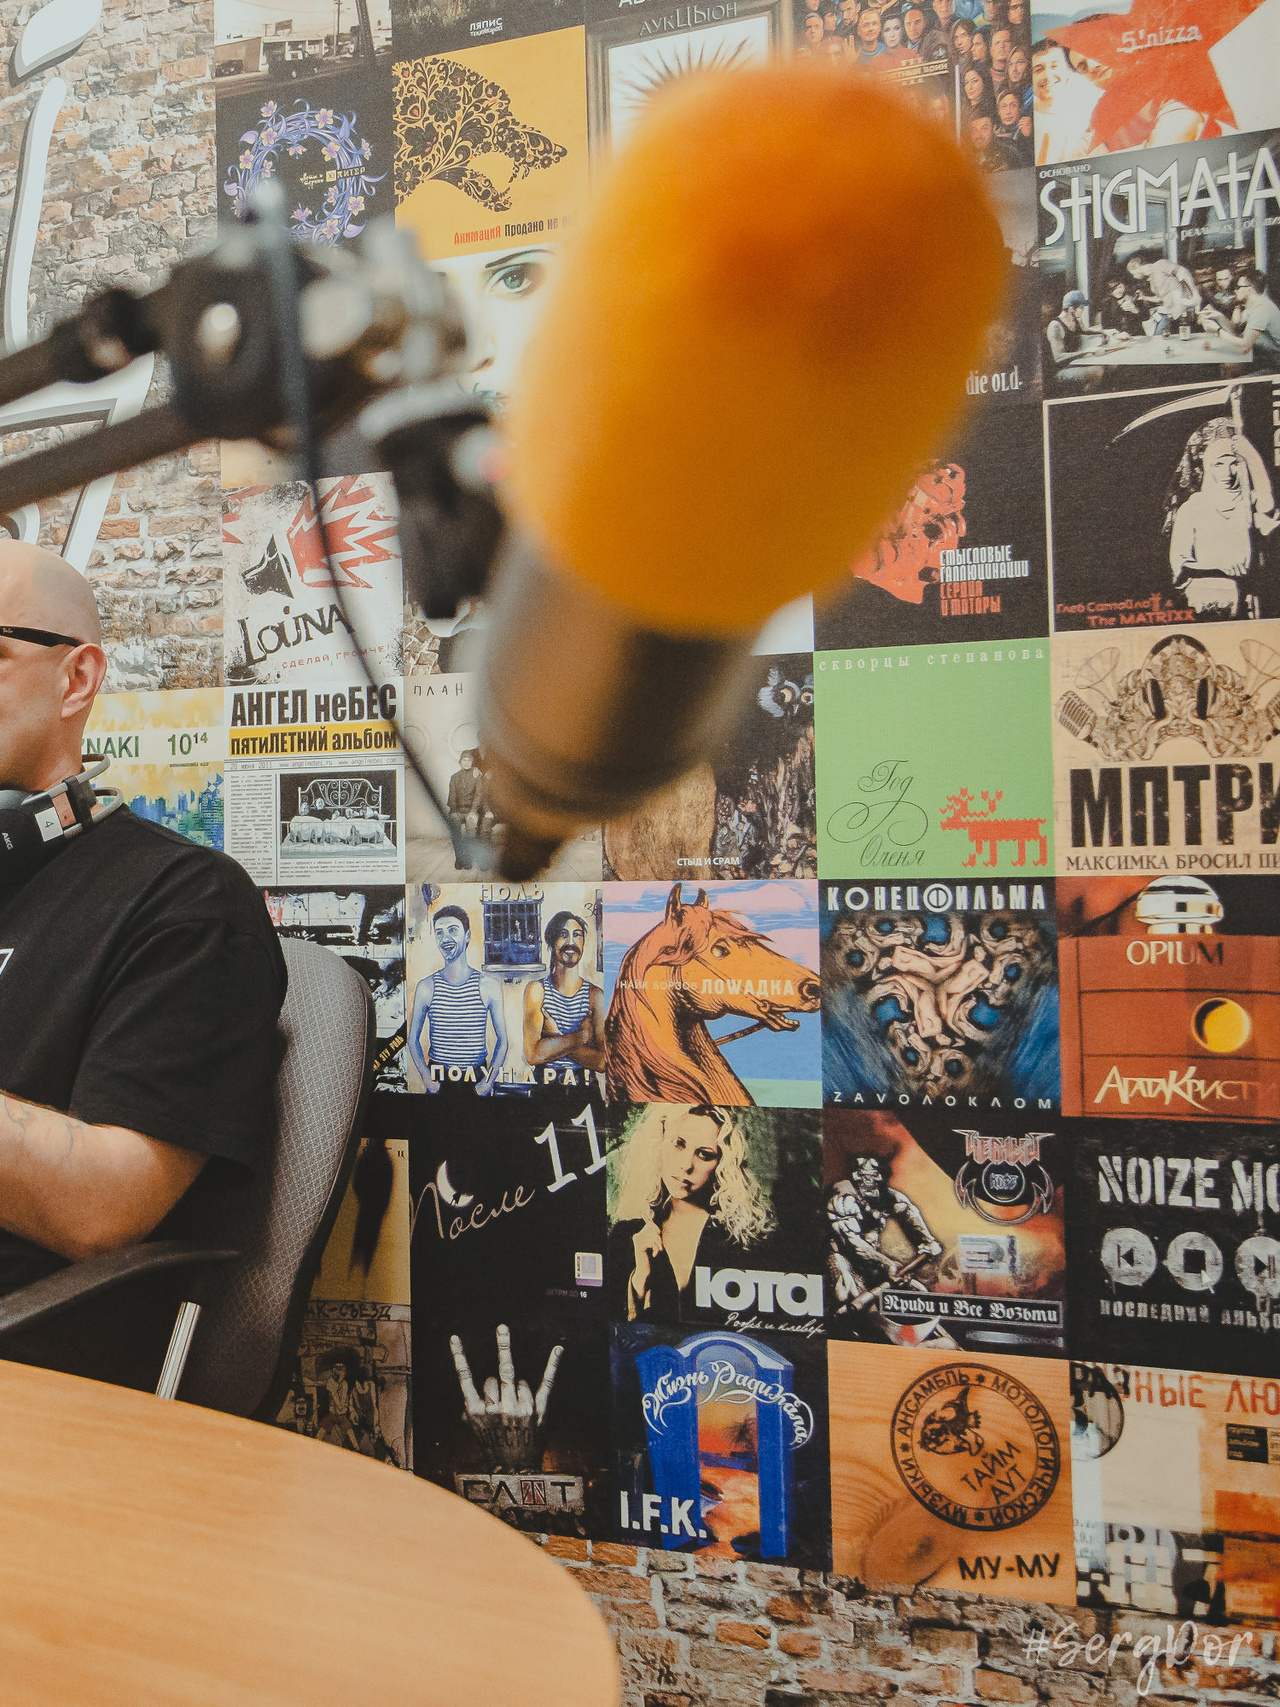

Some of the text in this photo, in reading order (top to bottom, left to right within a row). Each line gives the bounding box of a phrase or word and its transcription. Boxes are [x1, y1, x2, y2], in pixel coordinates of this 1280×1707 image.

[469, 17, 503, 31] ЛЯПИС
[504, 218, 544, 238] Продано
[1087, 609, 1197, 628] The MATRIXX
[281, 654, 331, 670] СДЕЛАЙ
[818, 647, 1046, 673] скворцы степанова
[413, 682, 464, 697] ПЛАН
[231, 683, 397, 727] АНГЕЛ неБЕС
[230, 725, 397, 756] пятиЛЕТНИЙ альбом
[44, 821, 55, 829] 4
[1, 832, 14, 851] AKG
[676, 856, 703, 867] СТЫД
[713, 856, 741, 866] СРАМ
[1066, 854, 1169, 871] МАКСИМКА
[1176, 853, 1252, 870] БРОСИЛ
[479, 883, 545, 901] НОЛЬ
[1126, 939, 1224, 966] OPIUM
[430, 1063, 592, 1087] ПОЛУНДРА!
[533, 1102, 608, 1194] 11
[1097, 1155, 1220, 1209] NOIZE
[579, 1290, 588, 1298] 16
[1099, 1299, 1211, 1323] ПОСЛЕДНИЙ
[897, 1368, 970, 1438] АНСАМБЛЬ
[959, 1440, 1022, 1492] ТАЙМ
[899, 1457, 968, 1524] МУЗЫКИ
[990, 1463, 1027, 1504] АУТ
[620, 1489, 708, 1539] I.F.K.
[957, 1552, 1061, 1581] МУ-МУ
